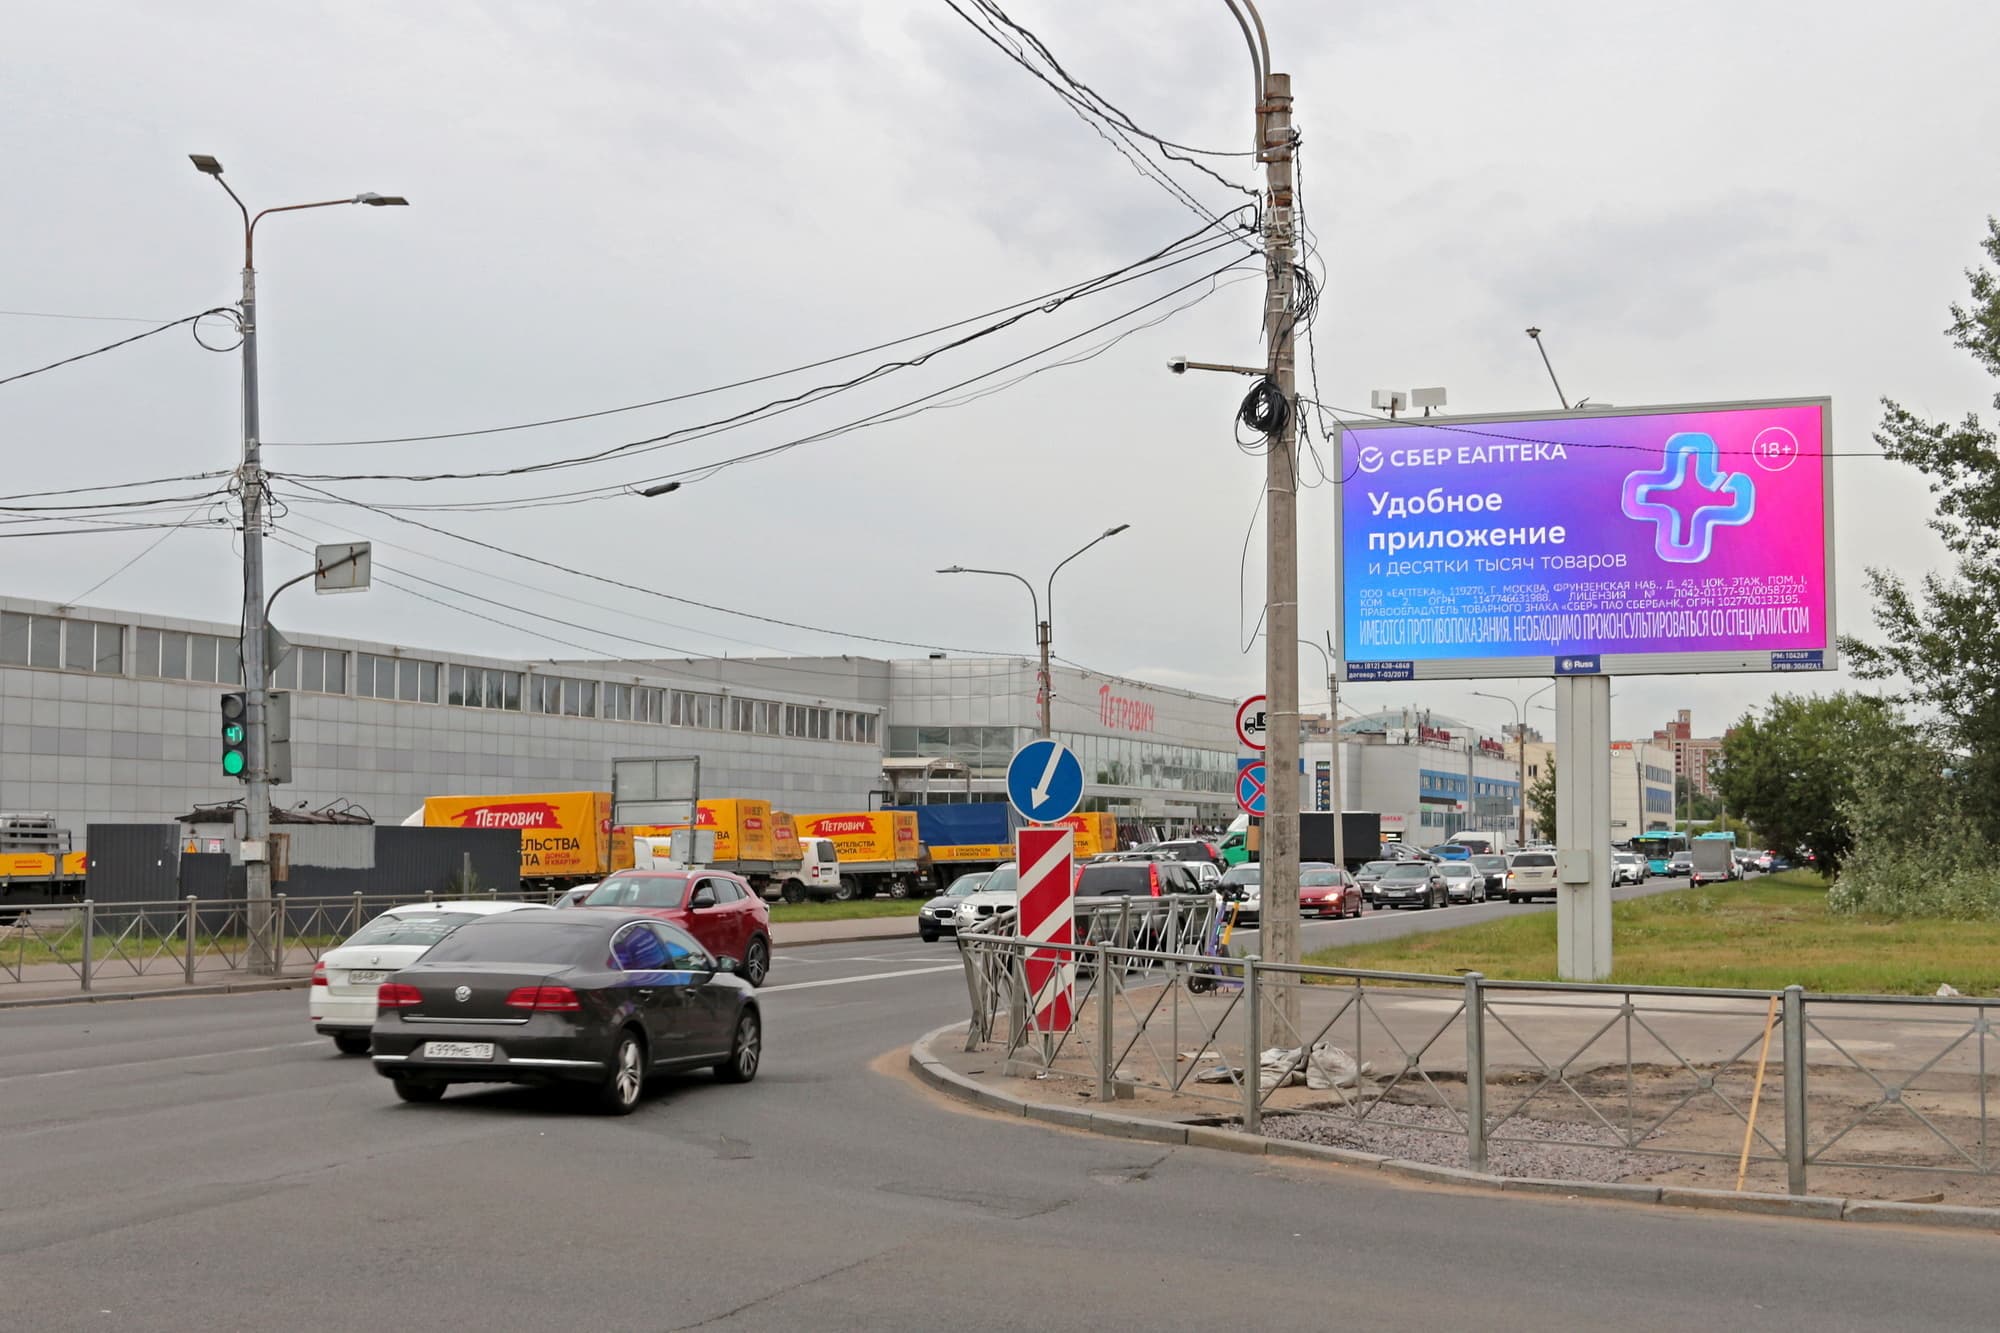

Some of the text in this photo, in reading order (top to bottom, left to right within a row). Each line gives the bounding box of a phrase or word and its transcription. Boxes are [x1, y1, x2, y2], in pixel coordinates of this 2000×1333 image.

[1390, 443, 1568, 467] СБЕР ЕАПТЕКА
[1760, 442, 1792, 459] 18+
[1367, 488, 1503, 519] Удобное
[1368, 525, 1567, 555] приложение
[1368, 552, 1627, 577] и десятки тысяч товаров
[1360, 589, 1383, 598] ООО
[1503, 584, 1550, 594] МОСКВА,
[1553, 581, 1631, 592] ФРУНЗЕНСКАЯ
[1428, 596, 1456, 606] ОГРН
[1568, 591, 1627, 602] ЛИЦЕНЗИЯ
[1644, 589, 1656, 600] №
[1360, 606, 1459, 617] ПРАВООБЛАДАТЕЛЬ
[1463, 603, 1522, 615] ТОВАРНОГО
[1525, 602, 1559, 612] ЗНАКА
[1562, 600, 1599, 611] «СБЕР»
[1601, 599, 1623, 609] ПАО
[1687, 596, 1715, 607] ОГРН
[1360, 607, 1810, 646] ИМЕЮТСЯ ПРОТИВОПОКАЗАНИЯ. НЕОБХОДИМО ПРОКОНСУЛЬТИРОВАТЬСЯ СО СПЕЦИАЛИСТОМ
[1574, 660, 1594, 669] Russ
[474, 808, 545, 828] ПЕТРОВИЧ
[820, 820, 865, 833] ПЕТРОВИЧ
